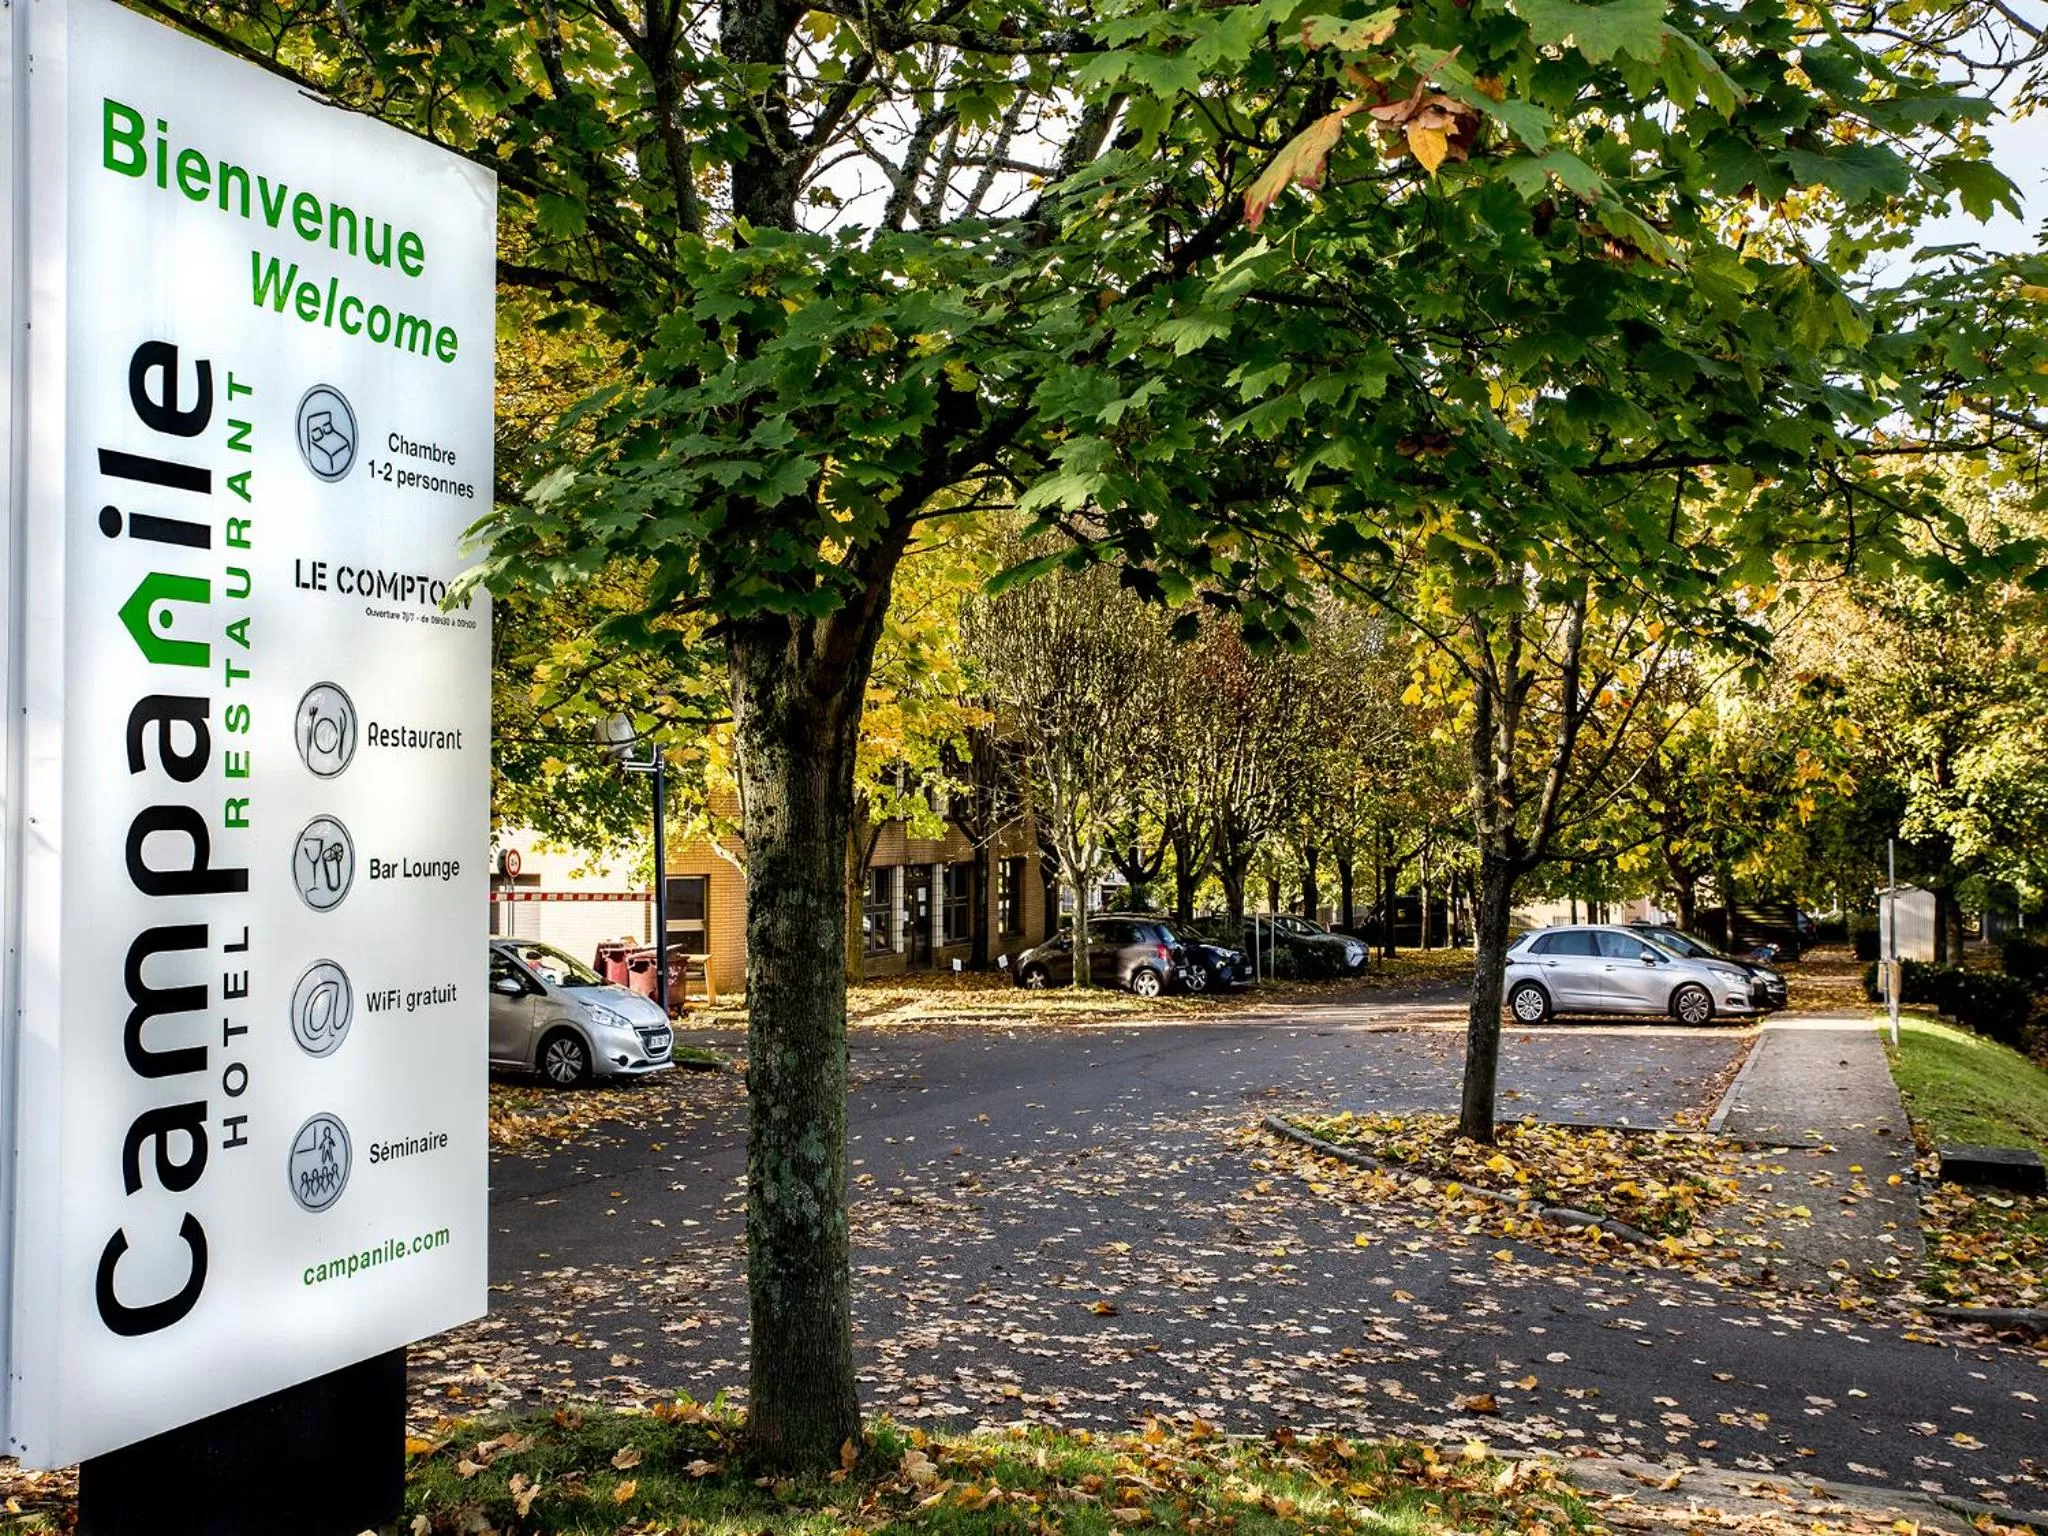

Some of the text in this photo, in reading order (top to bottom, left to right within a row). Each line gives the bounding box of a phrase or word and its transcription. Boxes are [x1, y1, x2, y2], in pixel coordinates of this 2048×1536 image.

[103, 97, 425, 278] Bienvenue
[251, 250, 459, 364] Welcome
[388, 432, 457, 466] Chambre
[368, 459, 475, 499] 1-2 personnes
[295, 558, 471, 610] LE COMPTO
[365, 607, 400, 620] Ouverture
[368, 721, 463, 750] Restaurant
[222, 370, 254, 1150] HOTEL RESTAURANT
[369, 857, 461, 882] Bar Lounge
[366, 984, 458, 1013] WiFi gratuit
[369, 1131, 448, 1165] Séminaire
[303, 1227, 450, 1286] campanile.com
